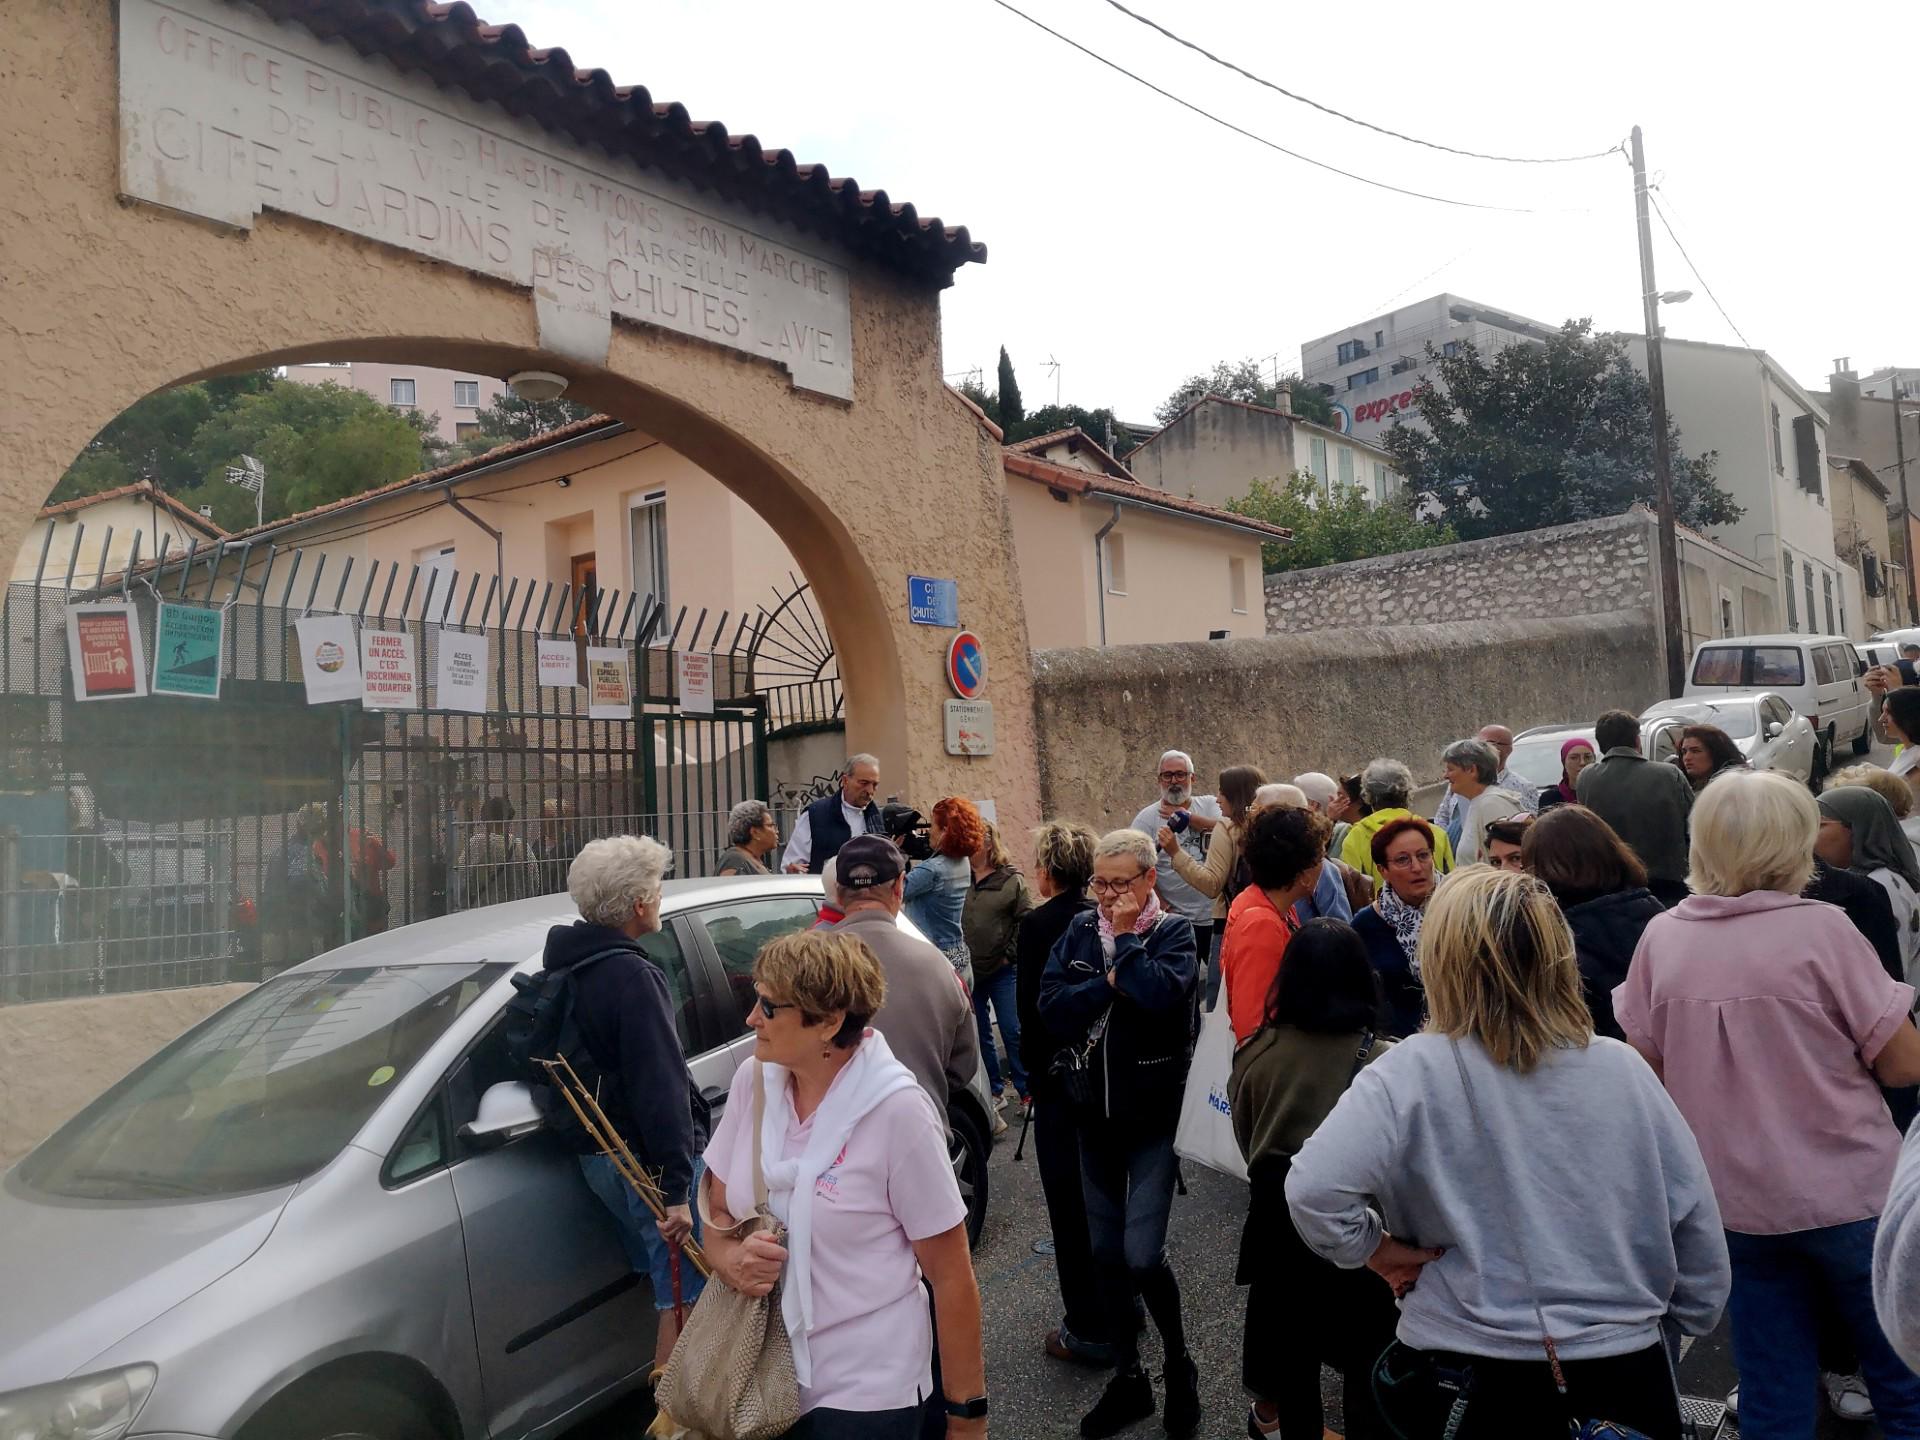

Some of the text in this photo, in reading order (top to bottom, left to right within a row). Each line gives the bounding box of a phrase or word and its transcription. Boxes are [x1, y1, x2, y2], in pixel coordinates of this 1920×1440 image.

[156, 15, 284, 96] OFFICE
[304, 68, 432, 150] PUBLIC
[684, 217, 728, 259] BON
[738, 234, 829, 295] MARCHE
[267, 103, 316, 147] DE
[337, 129, 381, 169] LA
[531, 199, 571, 236] DE
[604, 220, 749, 296] MARSEILLE
[532, 247, 596, 293] DES
[1354, 383, 1434, 423] expre
[368, 648, 380, 657] UN
[372, 635, 402, 646] FERMER
[366, 671, 412, 682] DISCRIMINER
[366, 682, 412, 693] UN QUARTIER
